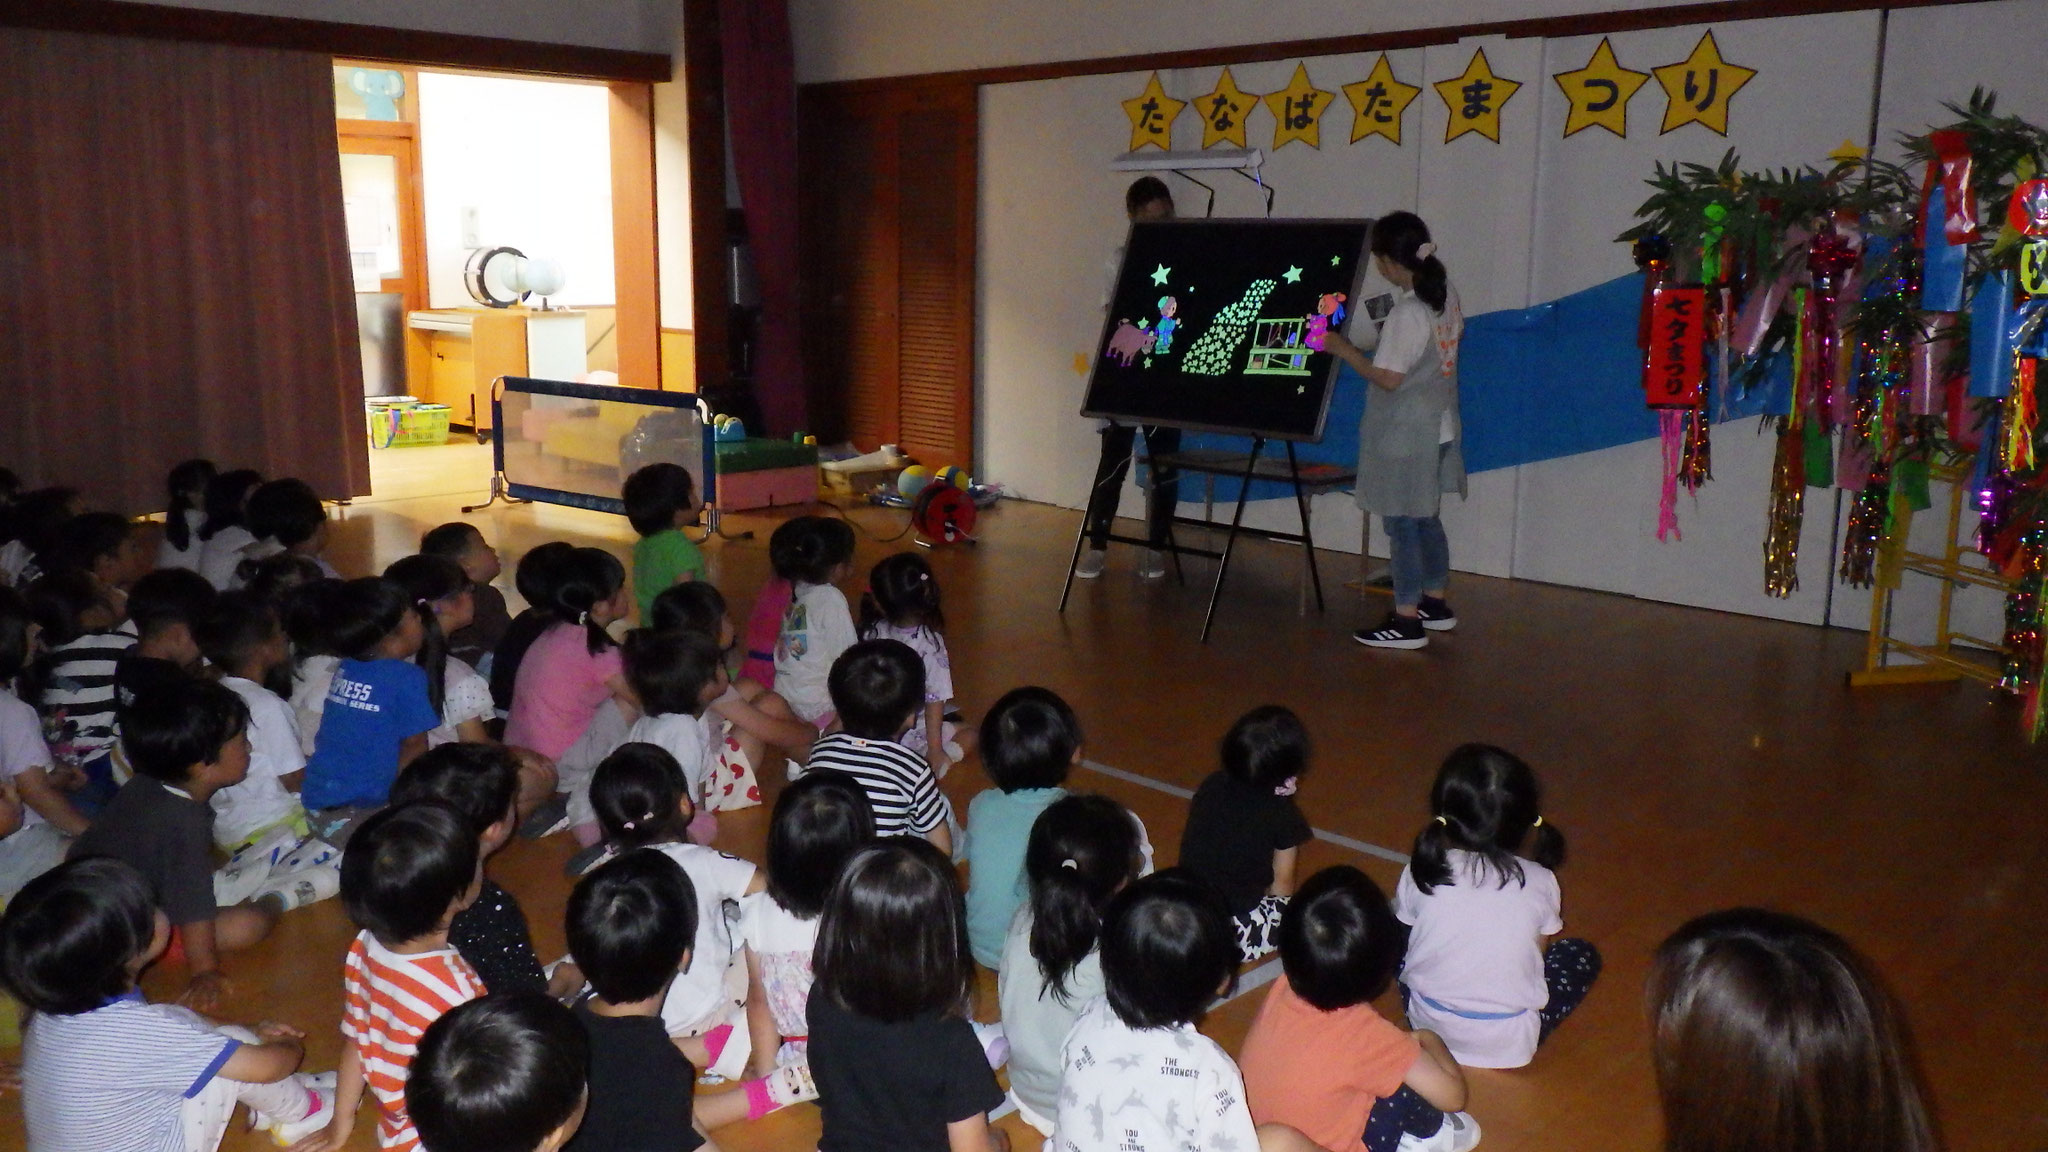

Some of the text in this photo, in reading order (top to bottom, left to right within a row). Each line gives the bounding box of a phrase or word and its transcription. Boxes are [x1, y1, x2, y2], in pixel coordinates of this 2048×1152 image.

[1139, 69, 1718, 134] たなばたまつり
[1664, 297, 1692, 395] 七夕まつり
[349, 700, 380, 712] SERIES
[1164, 1057, 1178, 1067] THE
[1214, 1088, 1228, 1101] YOU
[1125, 1129, 1139, 1138] YOU
